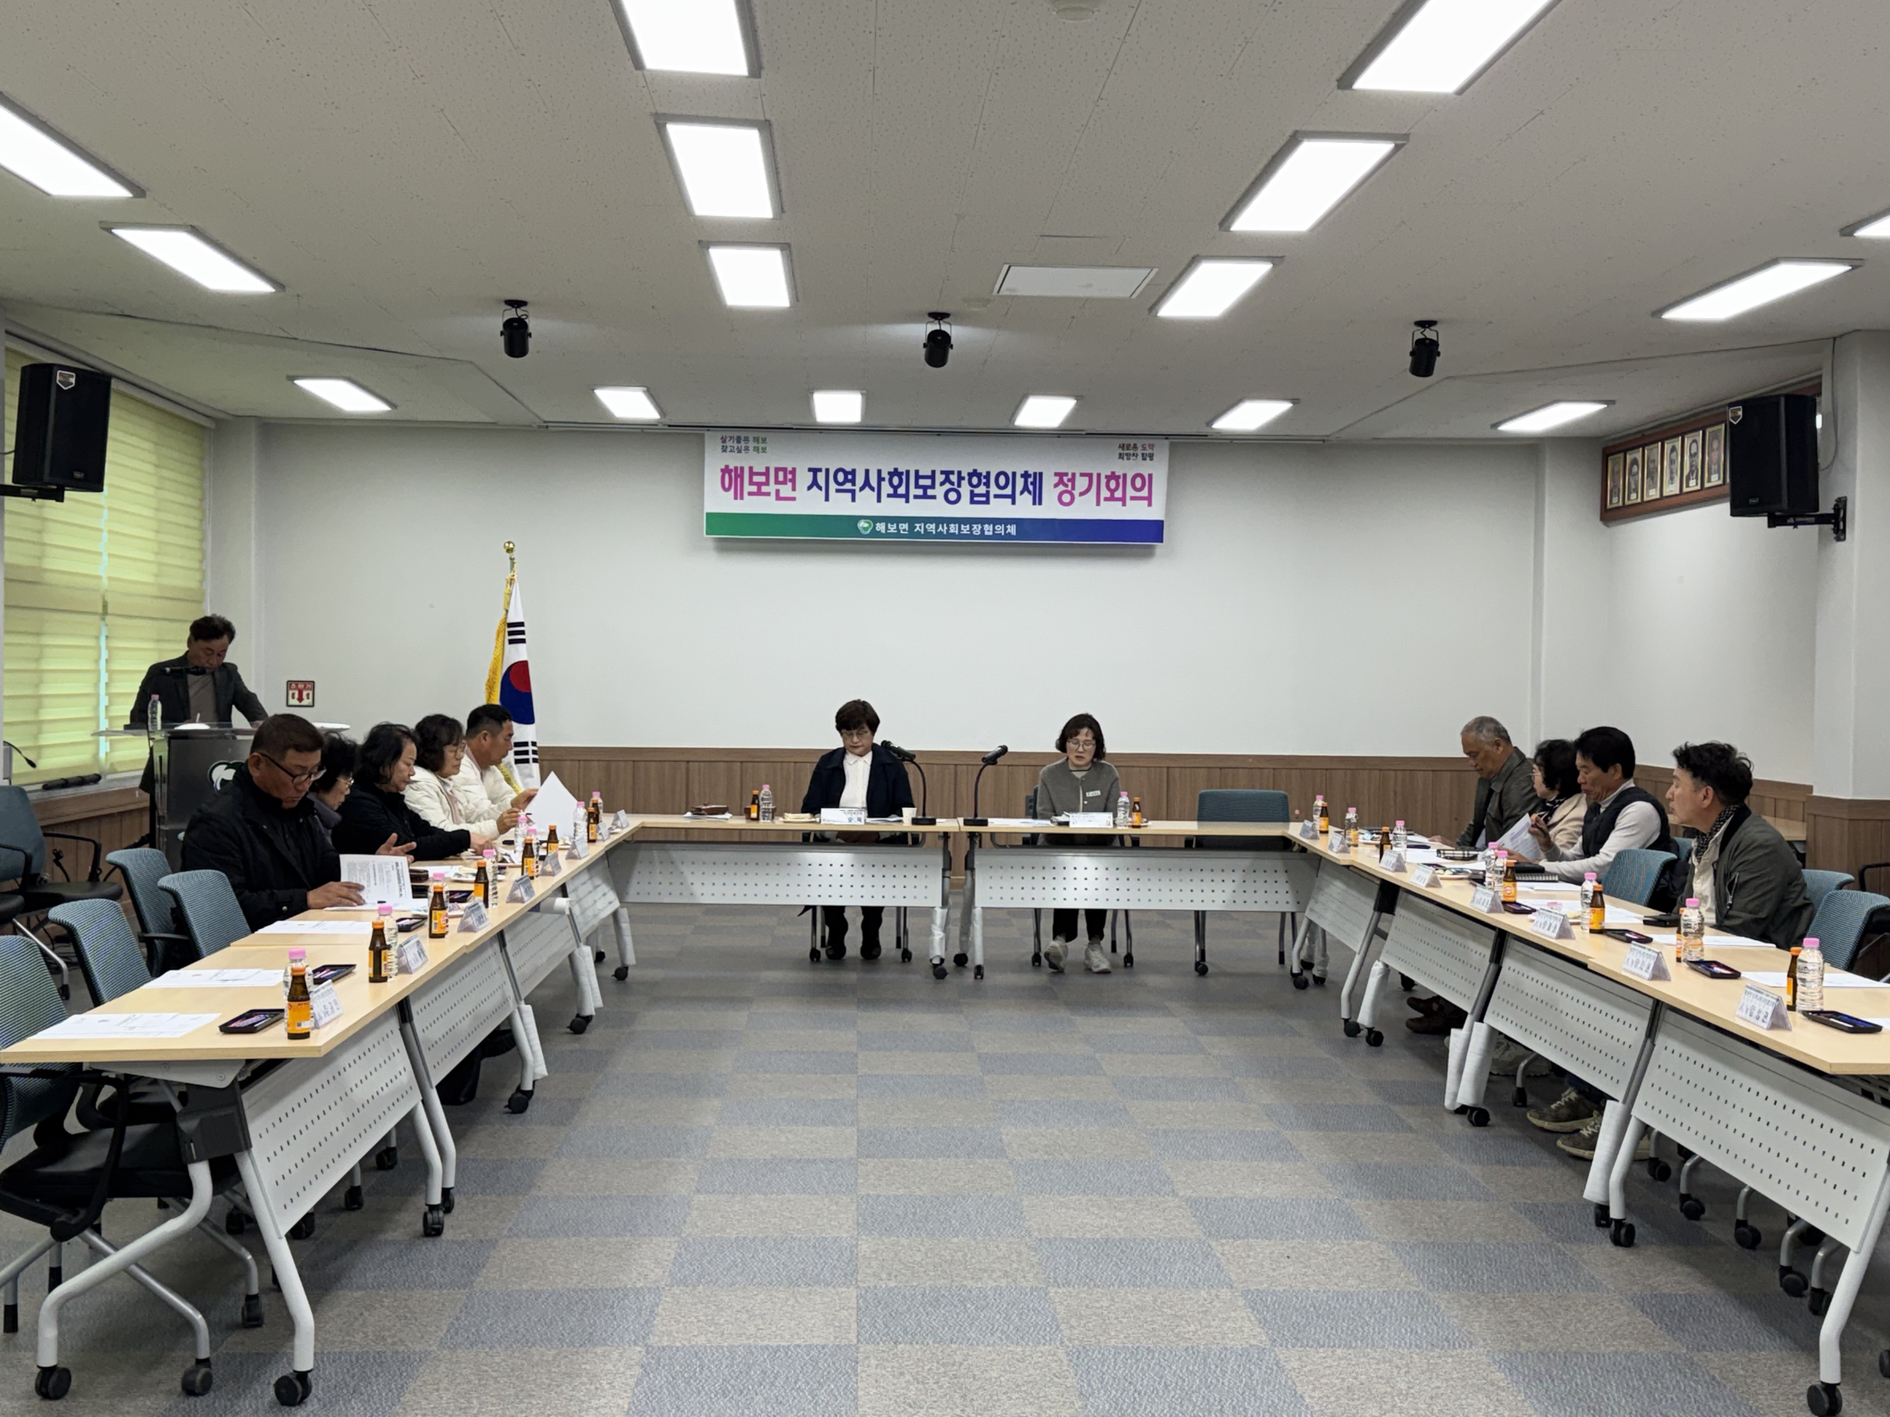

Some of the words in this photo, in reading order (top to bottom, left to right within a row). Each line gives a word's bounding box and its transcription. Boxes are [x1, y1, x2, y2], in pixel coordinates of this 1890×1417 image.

[720, 435, 750, 444] 살기좋은
[1118, 443, 1138, 452] 새로운
[720, 464, 797, 502] 해보면
[807, 466, 1043, 507] 지역사회보장협의체
[1053, 471, 1153, 507] 정기회의
[875, 522, 909, 534] 해보면
[914, 522, 1017, 536] 지역사회보장협의체
